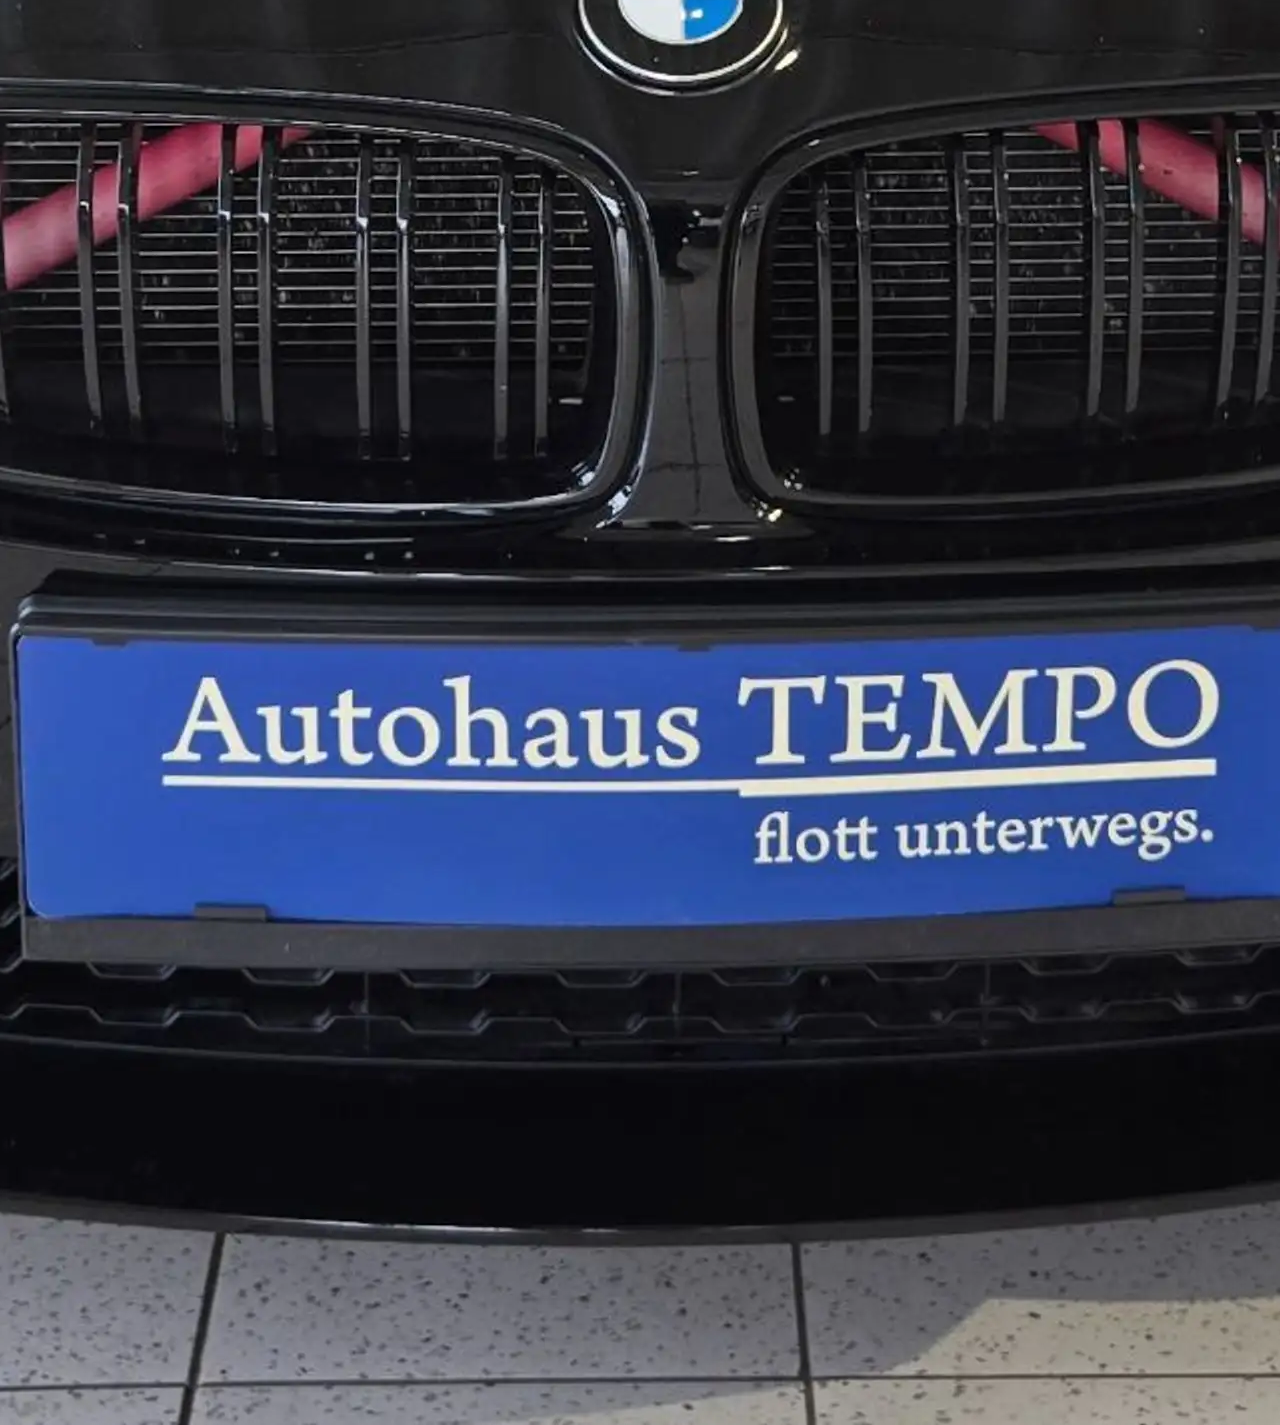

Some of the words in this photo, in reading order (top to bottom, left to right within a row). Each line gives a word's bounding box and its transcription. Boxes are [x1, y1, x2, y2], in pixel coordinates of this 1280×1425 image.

[161, 675, 700, 768] Autohaus
[738, 659, 1220, 765] TEMPO
[754, 811, 878, 864] flott
[895, 809, 1214, 861] unterwegs.
